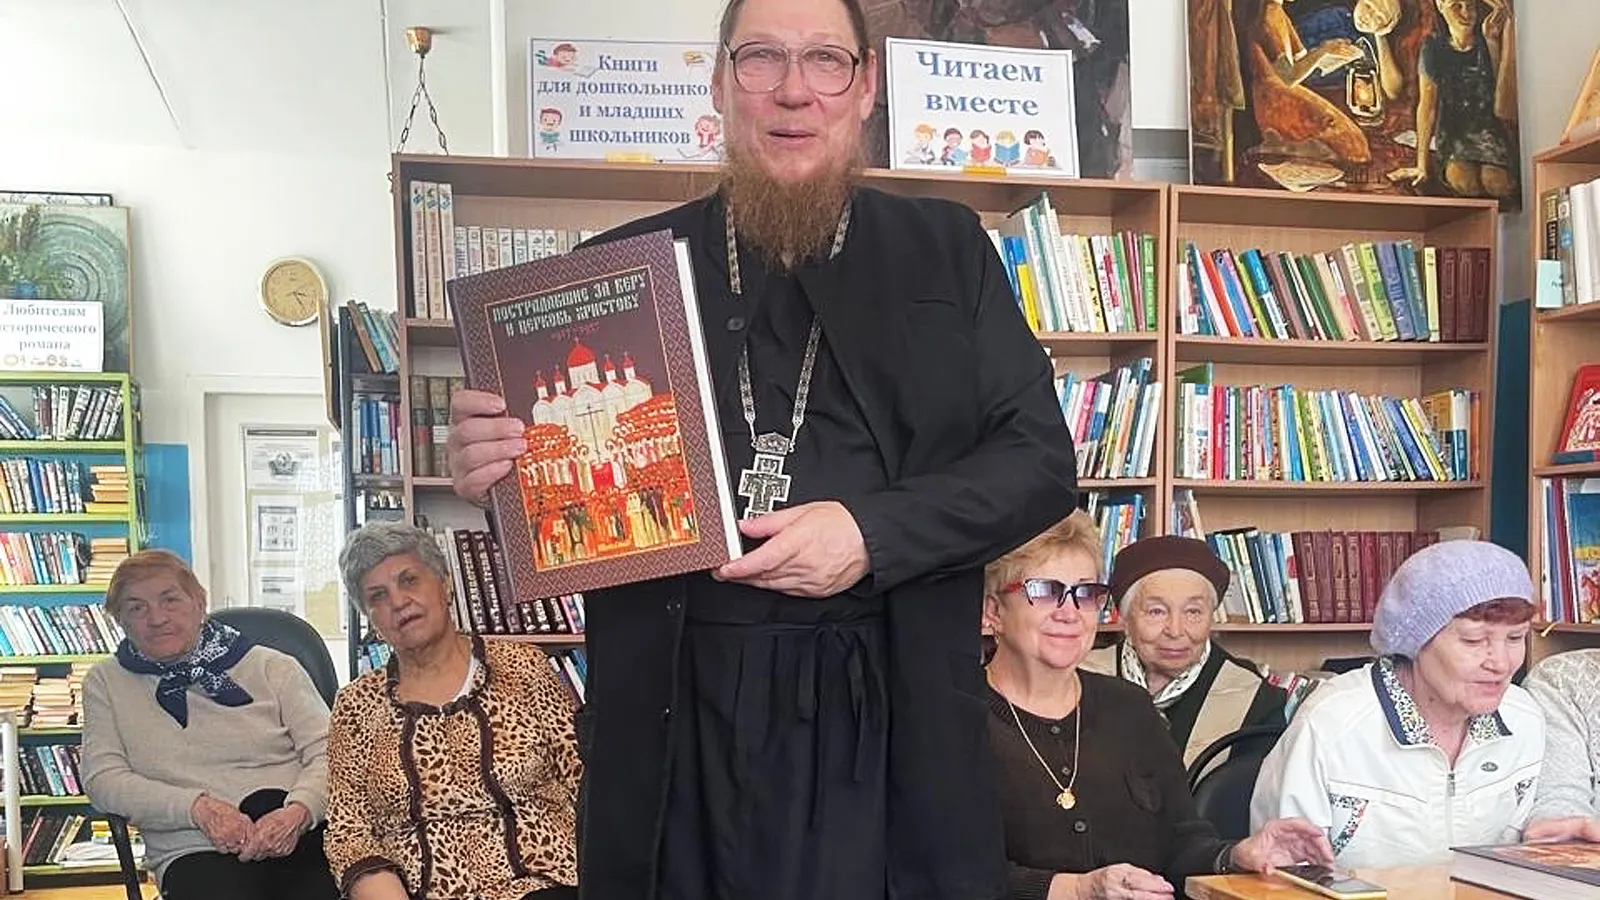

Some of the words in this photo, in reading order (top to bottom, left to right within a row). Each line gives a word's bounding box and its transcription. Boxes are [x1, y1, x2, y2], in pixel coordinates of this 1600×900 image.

[598, 54, 658, 72] Книги
[916, 51, 1043, 82] Читаем
[537, 80, 571, 95] для
[576, 83, 713, 97] дошкольнико
[579, 105, 591, 117] и
[596, 105, 684, 120] младших
[926, 94, 1039, 116] вместе
[569, 129, 691, 144] школьников
[593, 280, 611, 298] ЗА
[3, 303, 86, 317] Любителям
[505, 322, 515, 337] И
[19, 341, 71, 352] романа
